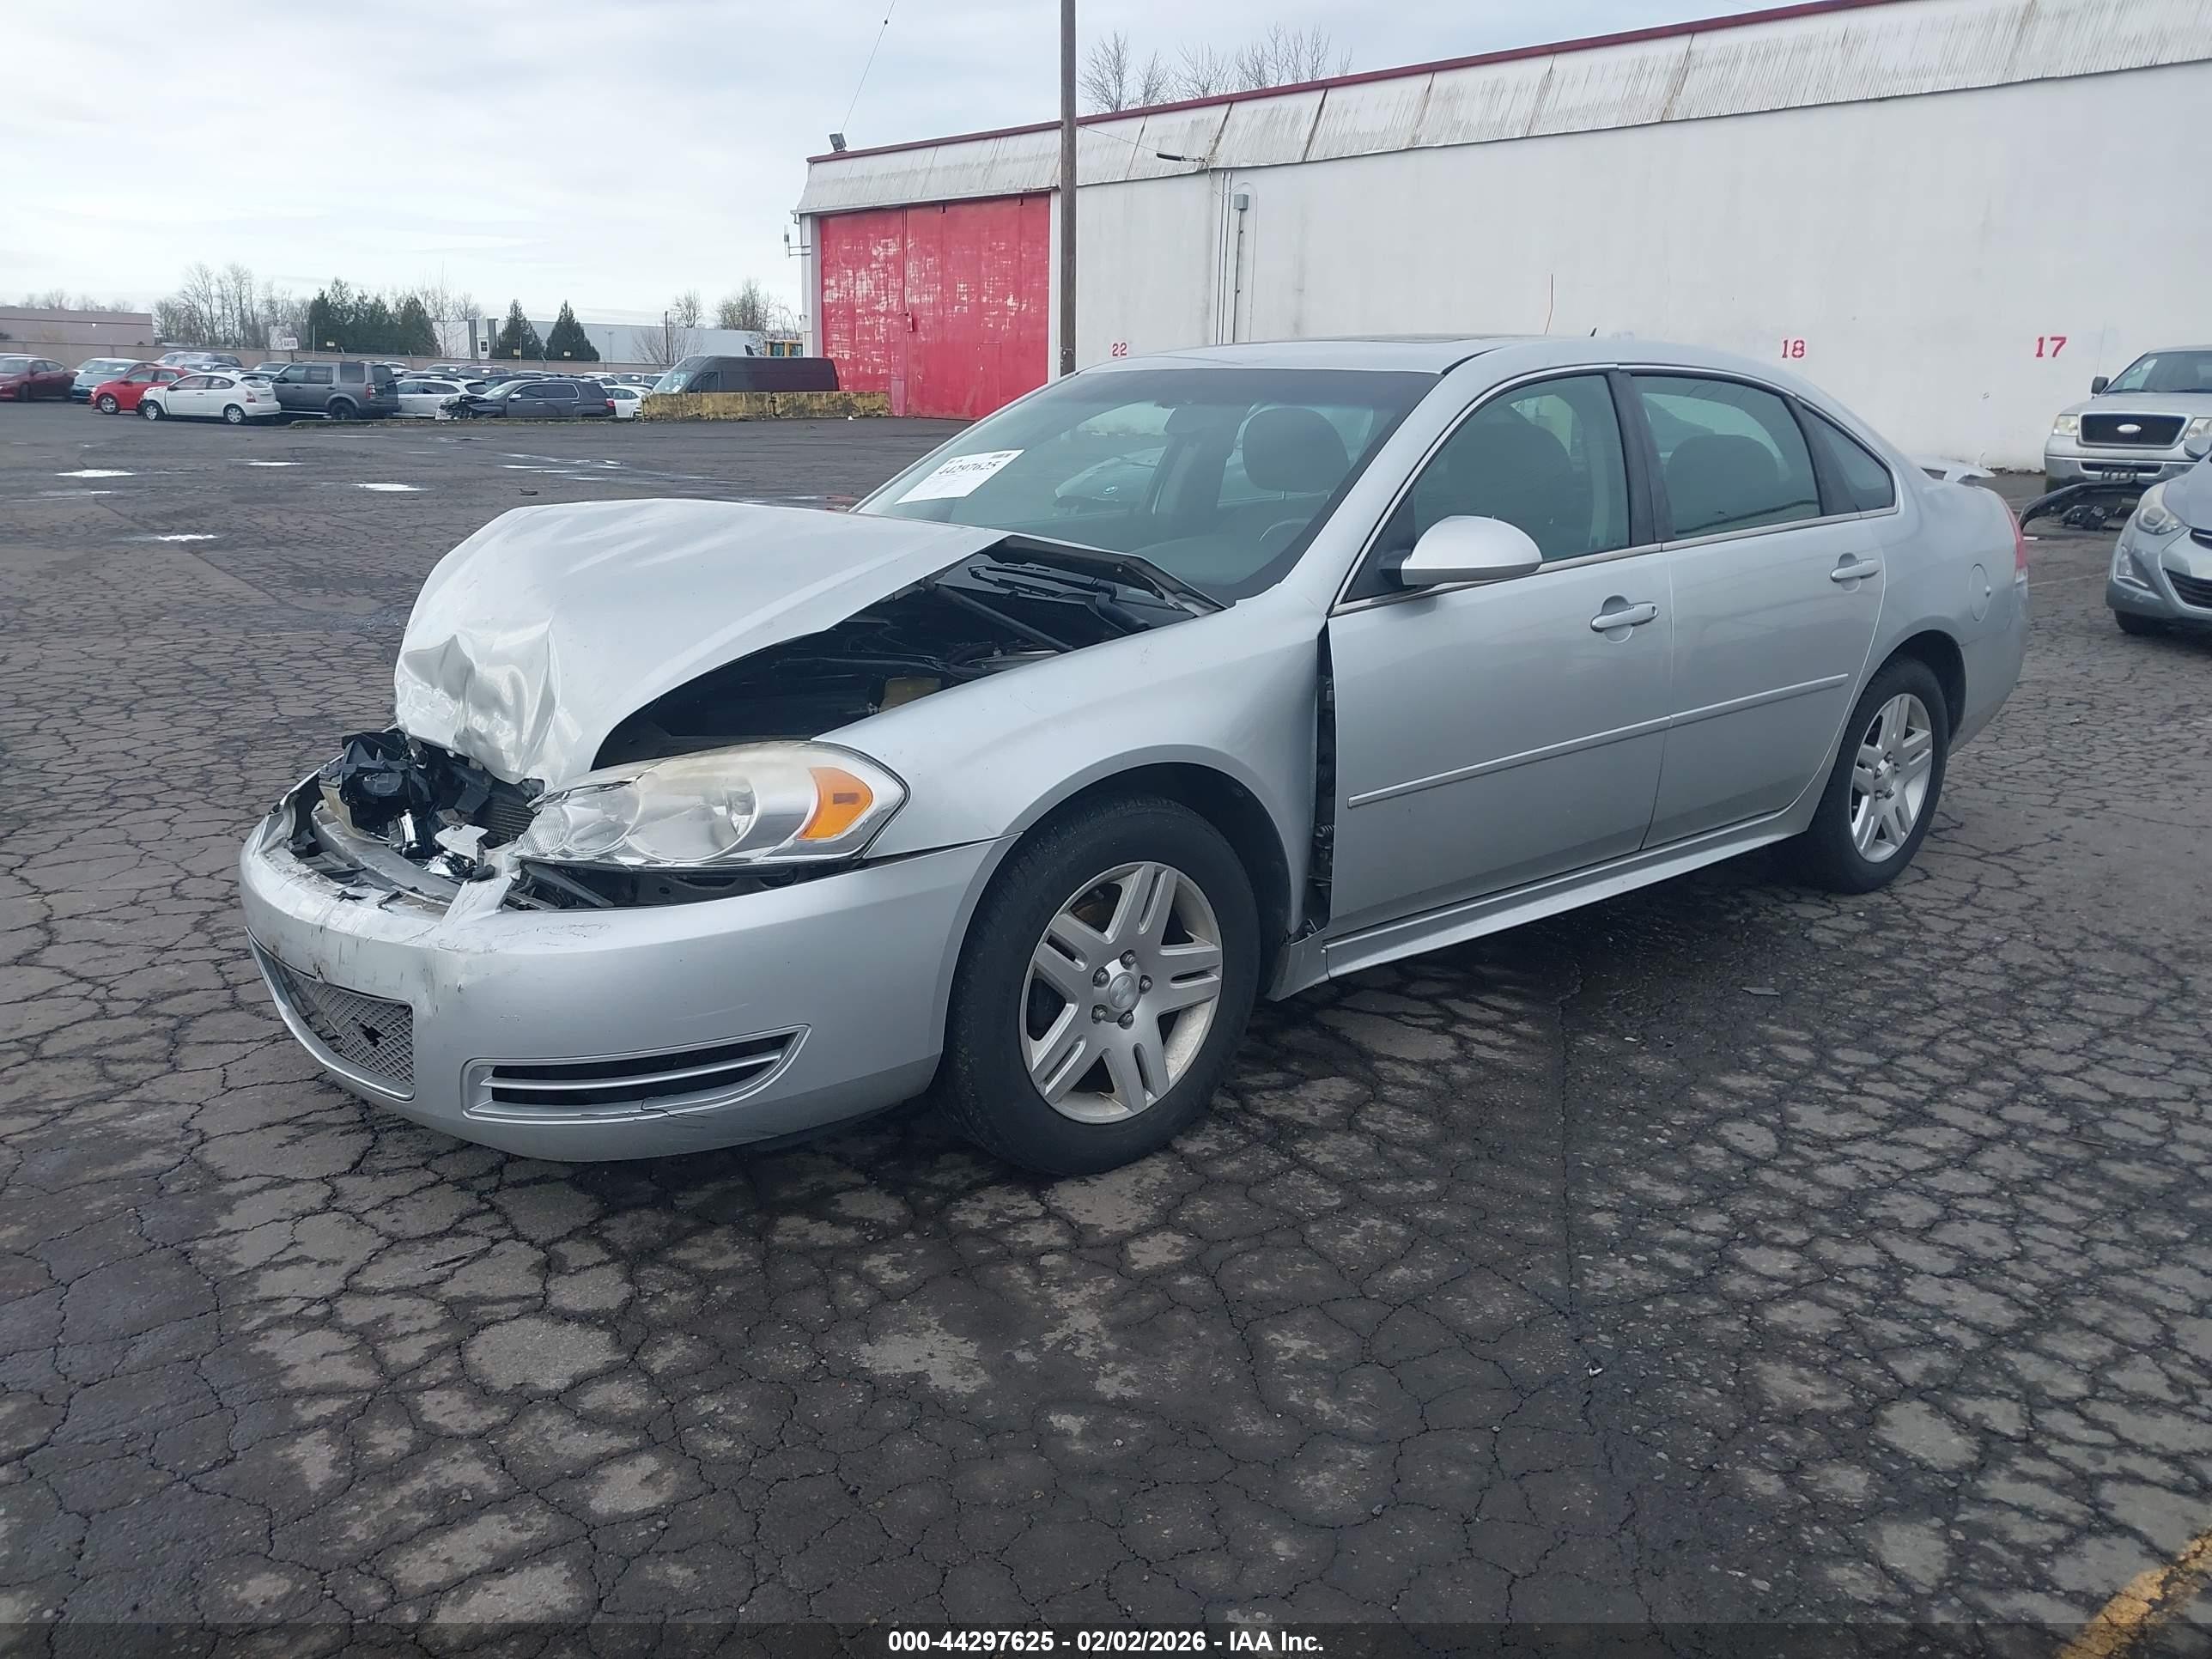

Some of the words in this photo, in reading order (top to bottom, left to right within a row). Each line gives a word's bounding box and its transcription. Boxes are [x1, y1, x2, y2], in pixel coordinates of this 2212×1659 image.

[1112, 342, 1127, 356] 22
[1782, 339, 1805, 358] 18
[2036, 336, 2067, 358] 17
